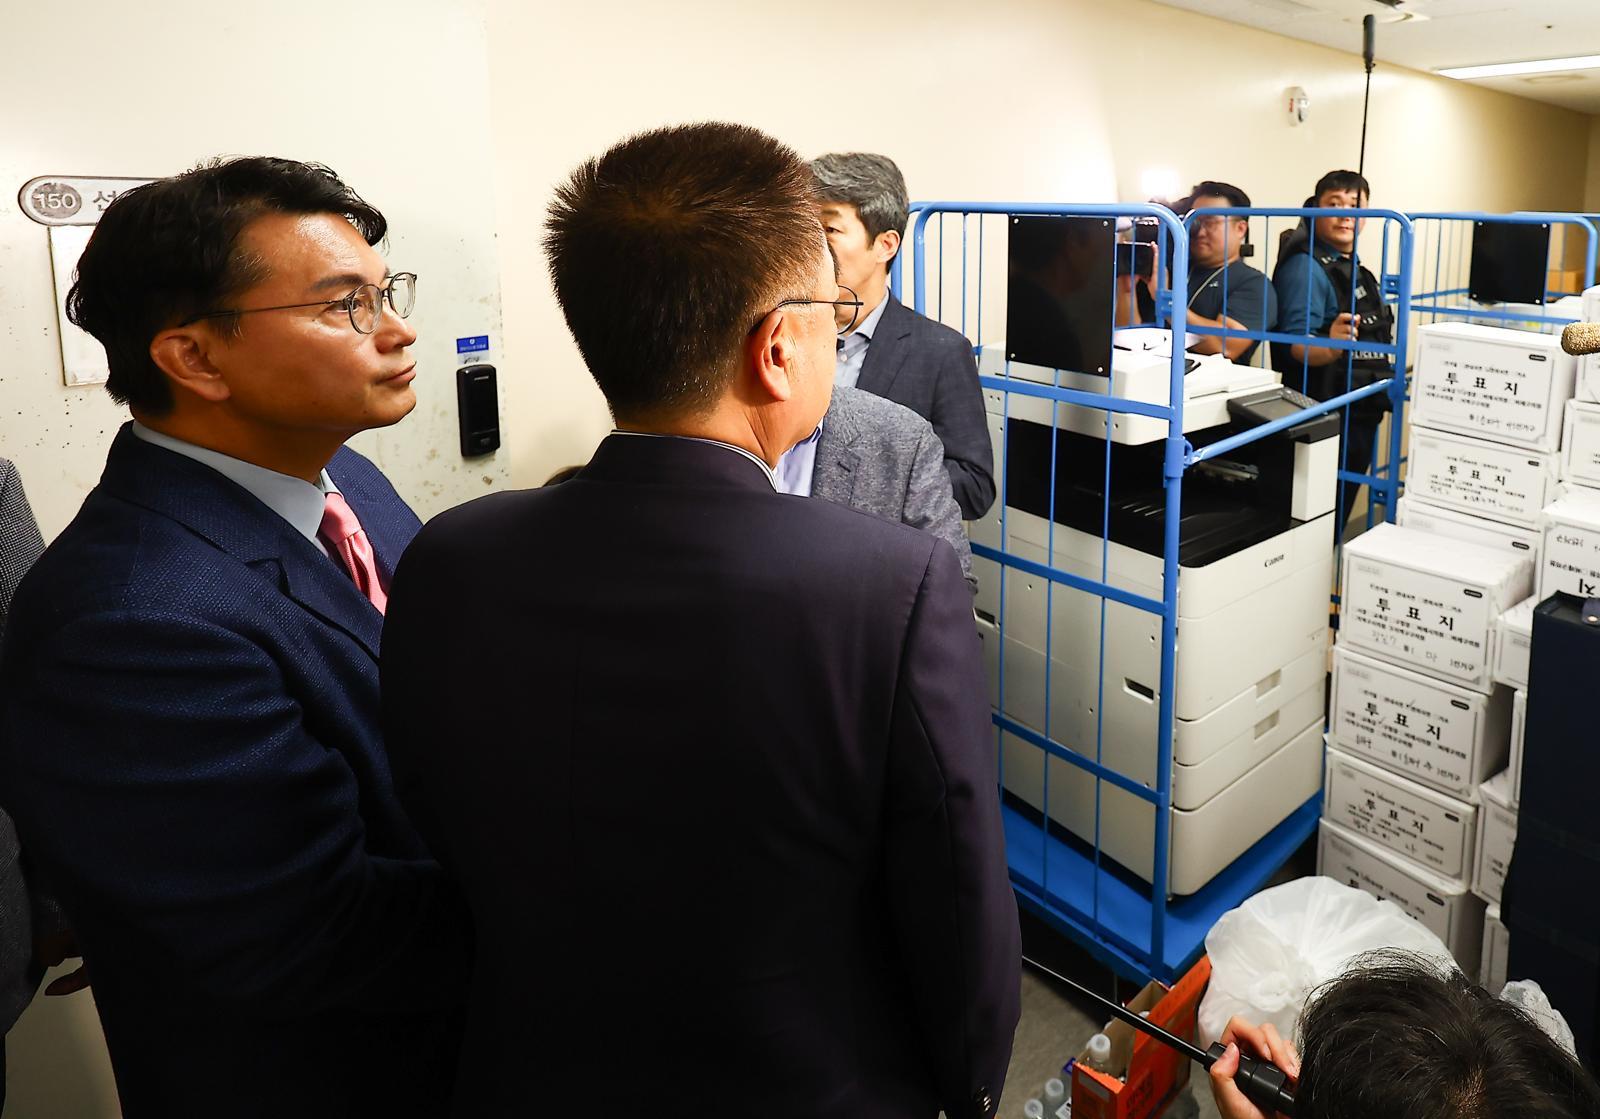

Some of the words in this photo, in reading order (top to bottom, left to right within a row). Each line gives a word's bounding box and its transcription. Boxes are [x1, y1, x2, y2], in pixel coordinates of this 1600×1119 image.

[37, 193, 77, 209] 150
[1446, 372, 1459, 385] 투
[1473, 377, 1487, 389] 표
[1504, 382, 1518, 395] 지
[1264, 553, 1284, 568] Canon
[1376, 598, 1391, 612] 투
[1406, 606, 1421, 620] 표
[1439, 615, 1453, 631] 지
[1364, 702, 1379, 716] 투
[1394, 713, 1409, 728] 표
[1426, 723, 1440, 740] 지
